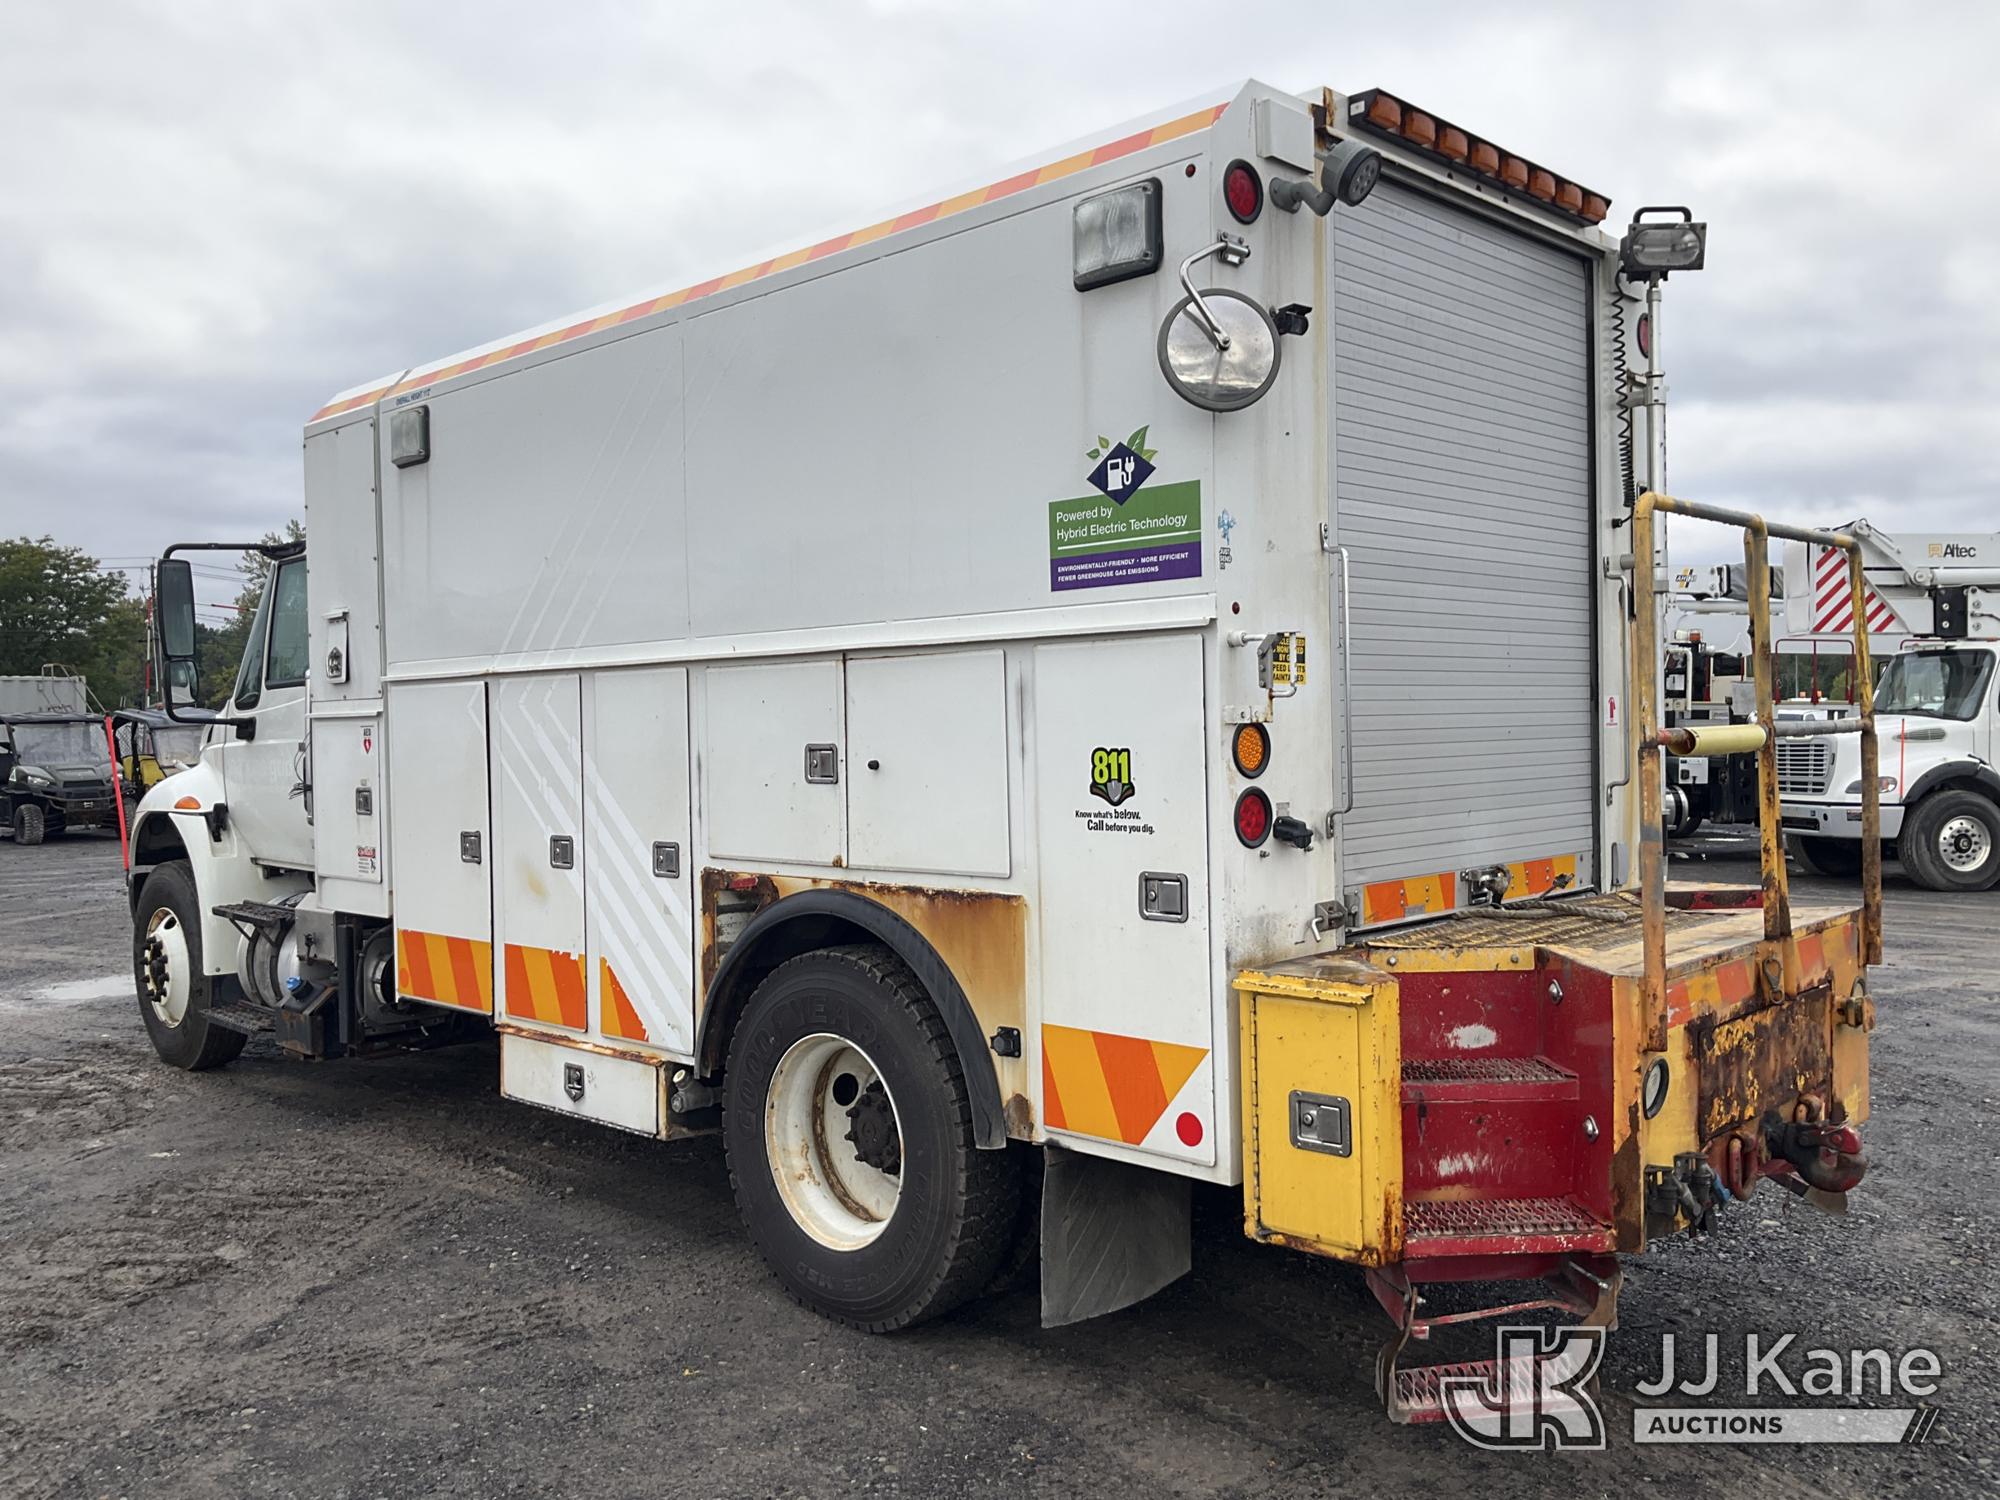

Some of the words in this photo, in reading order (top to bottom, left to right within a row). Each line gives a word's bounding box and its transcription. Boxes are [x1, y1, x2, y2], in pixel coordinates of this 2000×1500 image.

[1056, 507, 1098, 523] Powered
[1100, 506, 1113, 519] by
[1056, 526, 1088, 542] Hybrid
[1090, 521, 1127, 536] Electric
[1129, 514, 1187, 530] Technology
[1140, 554, 1158, 564] MORE
[1159, 552, 1189, 562] EFFICIENT
[1943, 543, 1976, 558] Altec
[1057, 573, 1077, 583] FEWER
[1077, 570, 1114, 581] GREENHOUSE
[1114, 569, 1127, 577] GAS
[1128, 565, 1159, 575] EMISSIONS
[1092, 749, 1130, 784] 811
[1075, 810, 1092, 818] Know
[1093, 810, 1113, 819] what's
[1114, 808, 1141, 820] below.
[1087, 819, 1104, 831] Call
[1105, 823, 1128, 832] before
[1128, 825, 1141, 834] you
[1141, 824, 1155, 835] dig.
